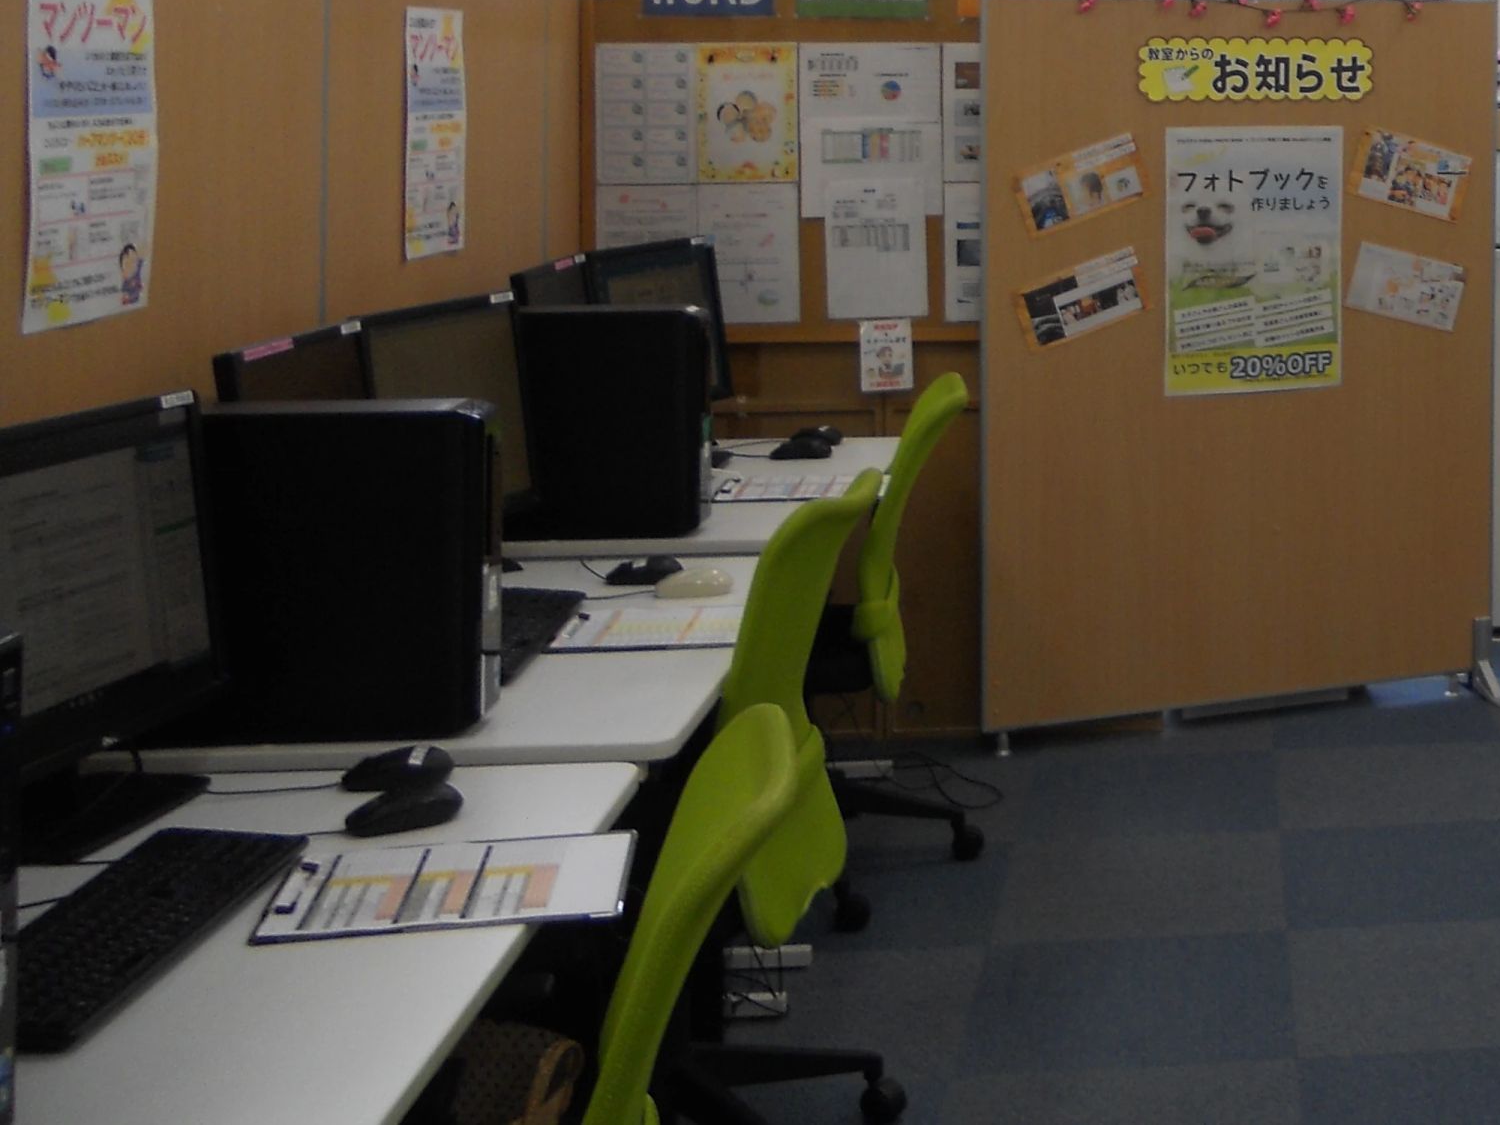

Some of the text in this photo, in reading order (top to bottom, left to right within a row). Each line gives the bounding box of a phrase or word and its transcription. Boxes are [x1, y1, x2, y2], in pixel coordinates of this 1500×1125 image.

[1148, 47, 1214, 61] 教室からの
[1212, 53, 1366, 94] お知らせ
[1177, 168, 1329, 192] フォトブックを
[1251, 197, 1331, 211] 作りましょう
[1173, 351, 1333, 379] いつでも 20%OFF
